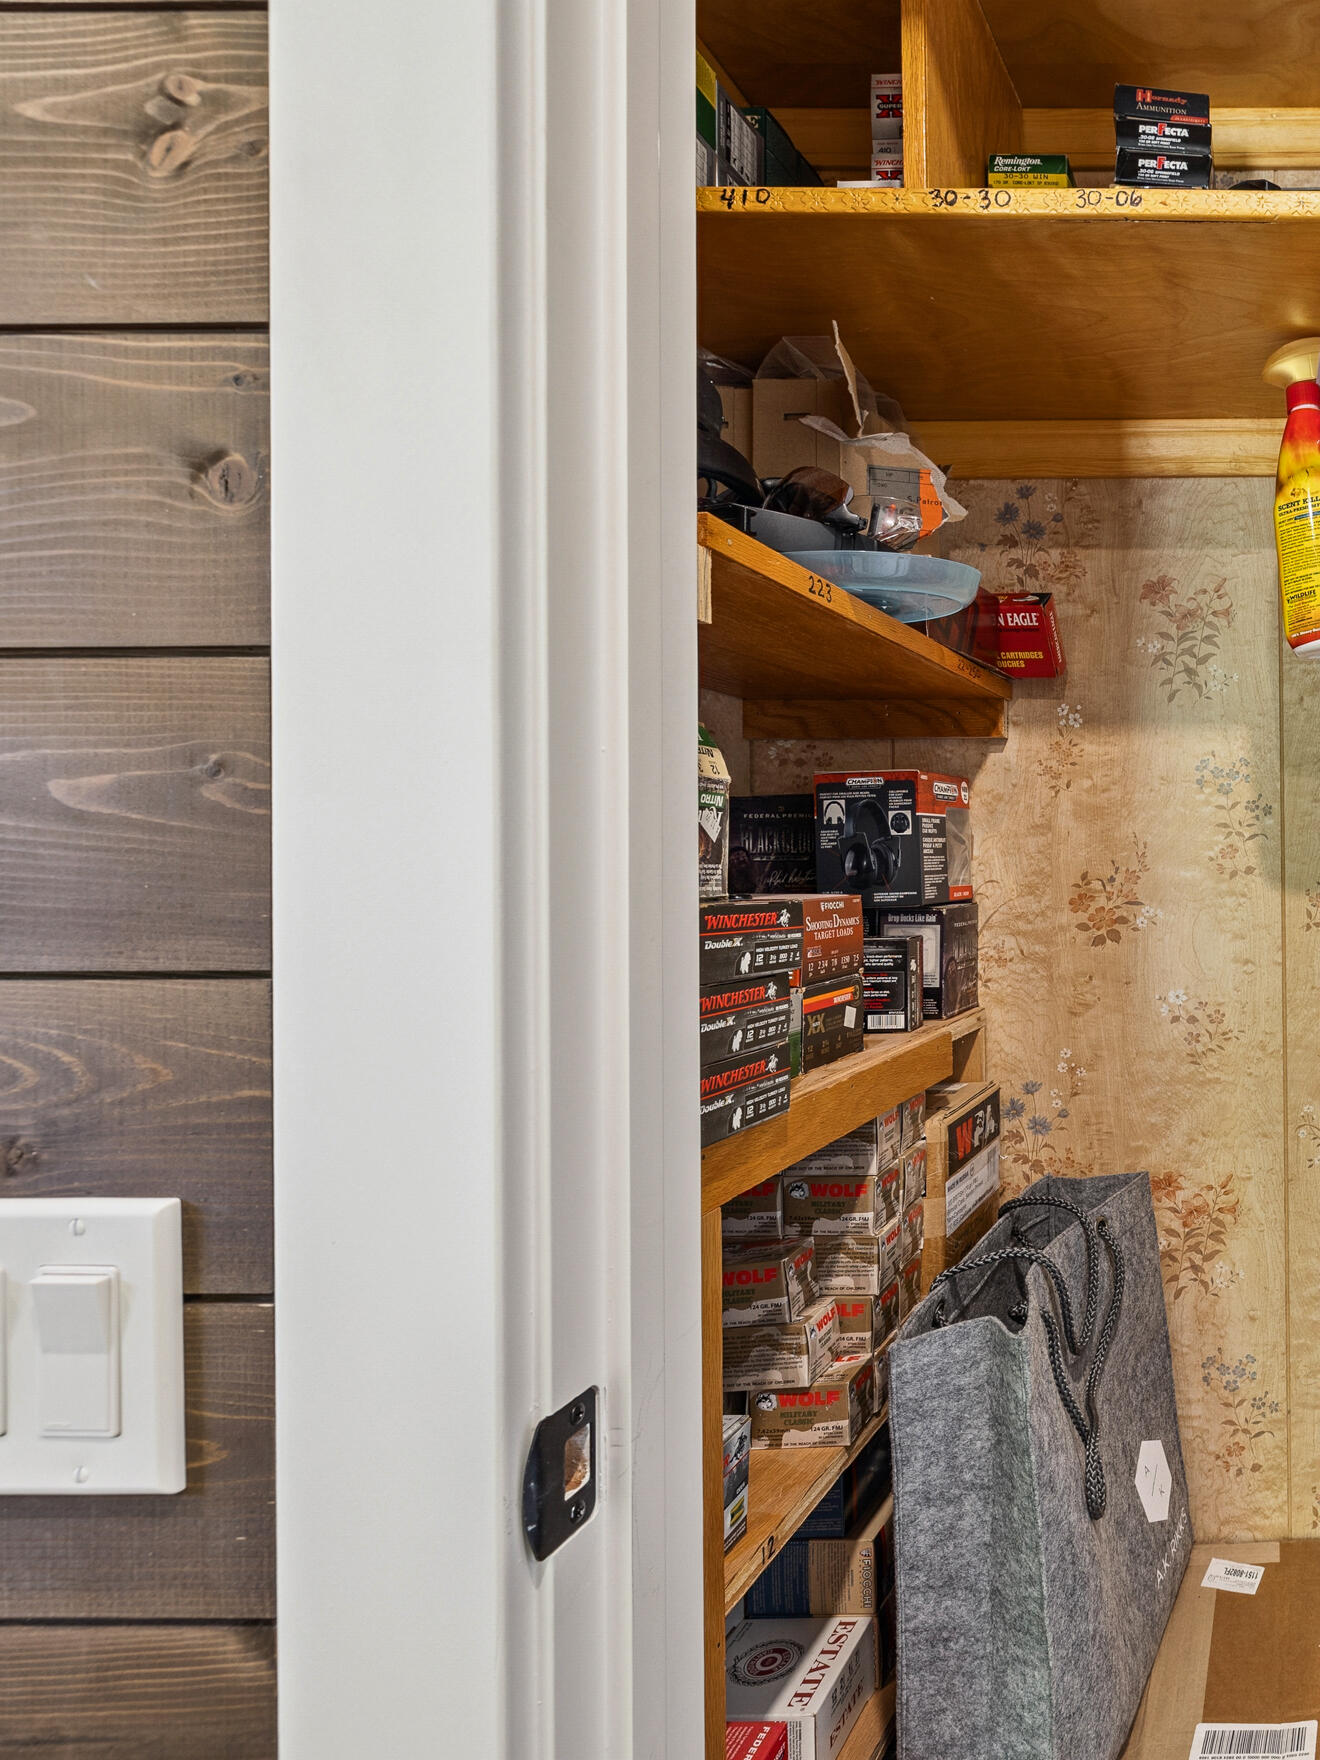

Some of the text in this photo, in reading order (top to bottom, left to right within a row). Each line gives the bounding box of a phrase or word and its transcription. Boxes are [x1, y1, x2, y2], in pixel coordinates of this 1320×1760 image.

[1136, 88, 1188, 105] Hornady
[1136, 102, 1187, 115] AMMUNITION
[1138, 122, 1189, 137] PERFECTA
[994, 156, 1042, 166] Remington
[1138, 155, 1188, 170] PERFECTA
[720, 188, 771, 209] 410
[928, 188, 1012, 210] 30-30
[1075, 189, 1143, 208] 30-06
[1278, 500, 1301, 511] SCENT
[807, 574, 833, 604] 223
[1289, 589, 1316, 600] WILDLIFE
[1006, 612, 1039, 626] EAGLE
[1000, 651, 1044, 660] CARTRIDGES
[700, 793, 724, 808] NITRO
[824, 901, 844, 910] FIOCCHI
[705, 912, 778, 930] WINCHESTER
[805, 913, 860, 932] SHOOTING DYNAMICS
[813, 930, 837, 941] TARGET
[836, 927, 854, 937] LOADS
[755, 953, 764, 963] 12
[700, 985, 766, 1012] WINCHESTER
[746, 1029, 754, 1039] 12
[700, 1059, 767, 1094] WINCHESTER
[883, 1110, 899, 1128] WOLF
[810, 1183, 869, 1198] WOLF
[885, 1223, 901, 1244] WOLF
[794, 1247, 814, 1270] WOLF
[815, 1306, 836, 1332] WOLF
[778, 1390, 841, 1408] WOLF
[780, 1410, 817, 1419] MILITARY
[761, 1535, 776, 1566] 12
[862, 1558, 873, 1609] FIOCCHI
[786, 1619, 860, 1708] ESTATE
[829, 1678, 864, 1748] ESTATE
[744, 1726, 771, 1760] FEDER
